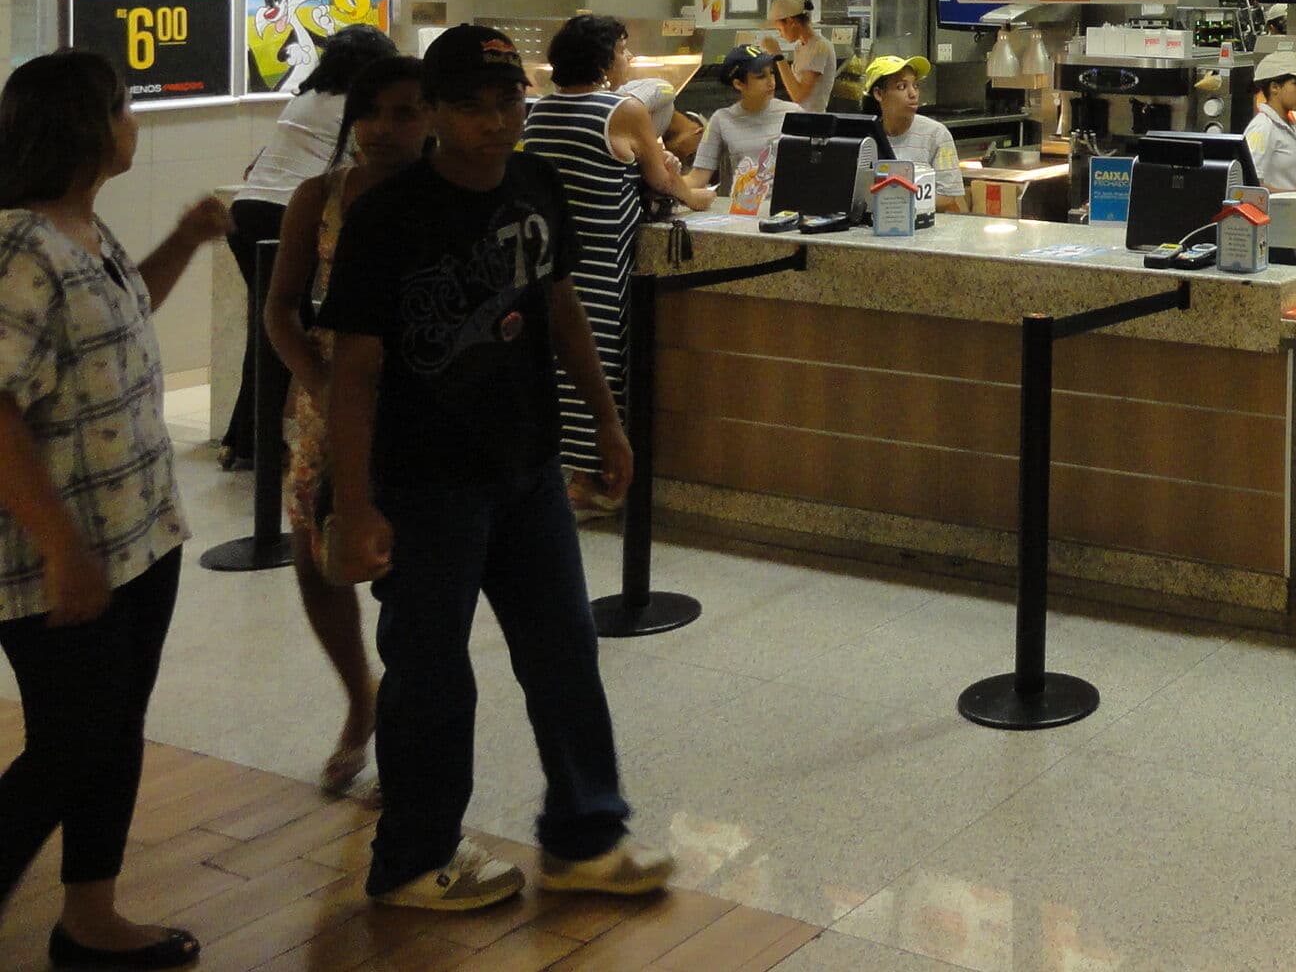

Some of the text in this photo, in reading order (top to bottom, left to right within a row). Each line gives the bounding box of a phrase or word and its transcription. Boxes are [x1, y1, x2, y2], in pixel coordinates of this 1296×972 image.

[1094, 170, 1130, 181] CAIXA
[915, 183, 932, 201] 02
[496, 213, 553, 288] 72
